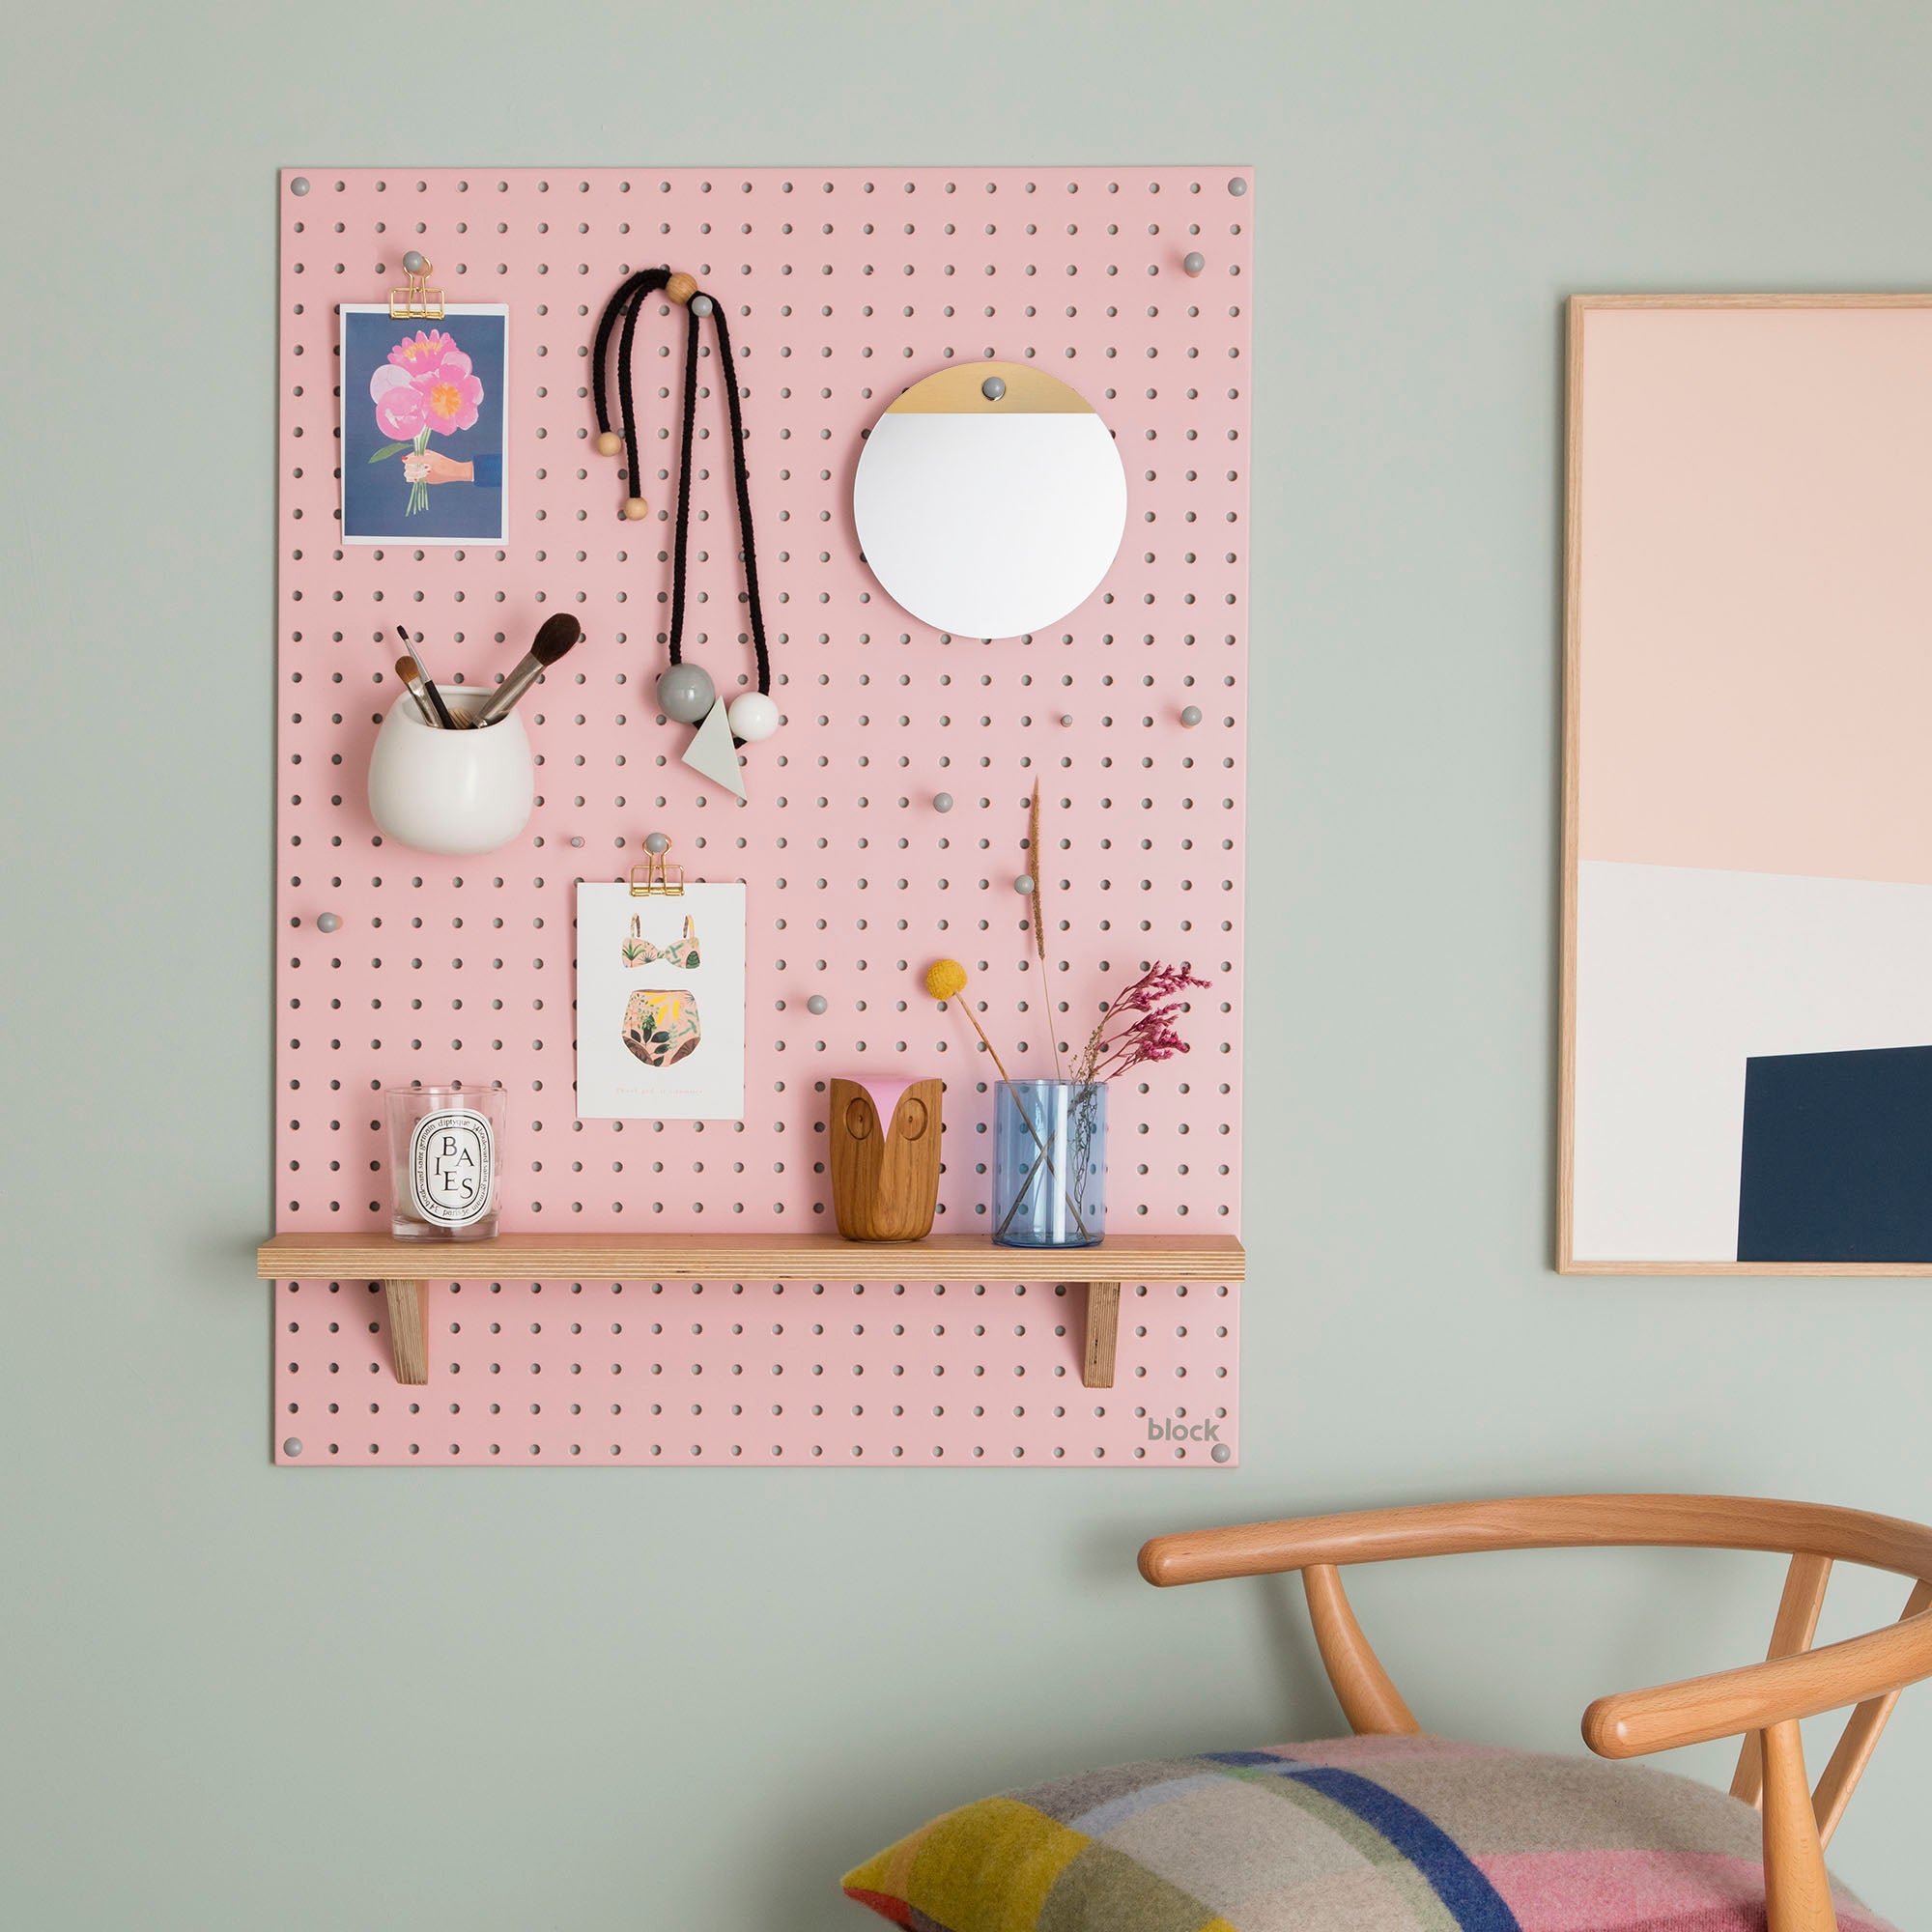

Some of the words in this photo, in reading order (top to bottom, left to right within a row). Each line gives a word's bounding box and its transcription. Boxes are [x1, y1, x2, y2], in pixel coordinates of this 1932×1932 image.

[419, 1123, 436, 1151] germain
[438, 1119, 470, 1127] diptyque
[479, 1127, 489, 1163] boulevard
[417, 1170, 431, 1208] boulevard
[471, 1183, 487, 1211] germain
[1148, 1417, 1220, 1442] block
